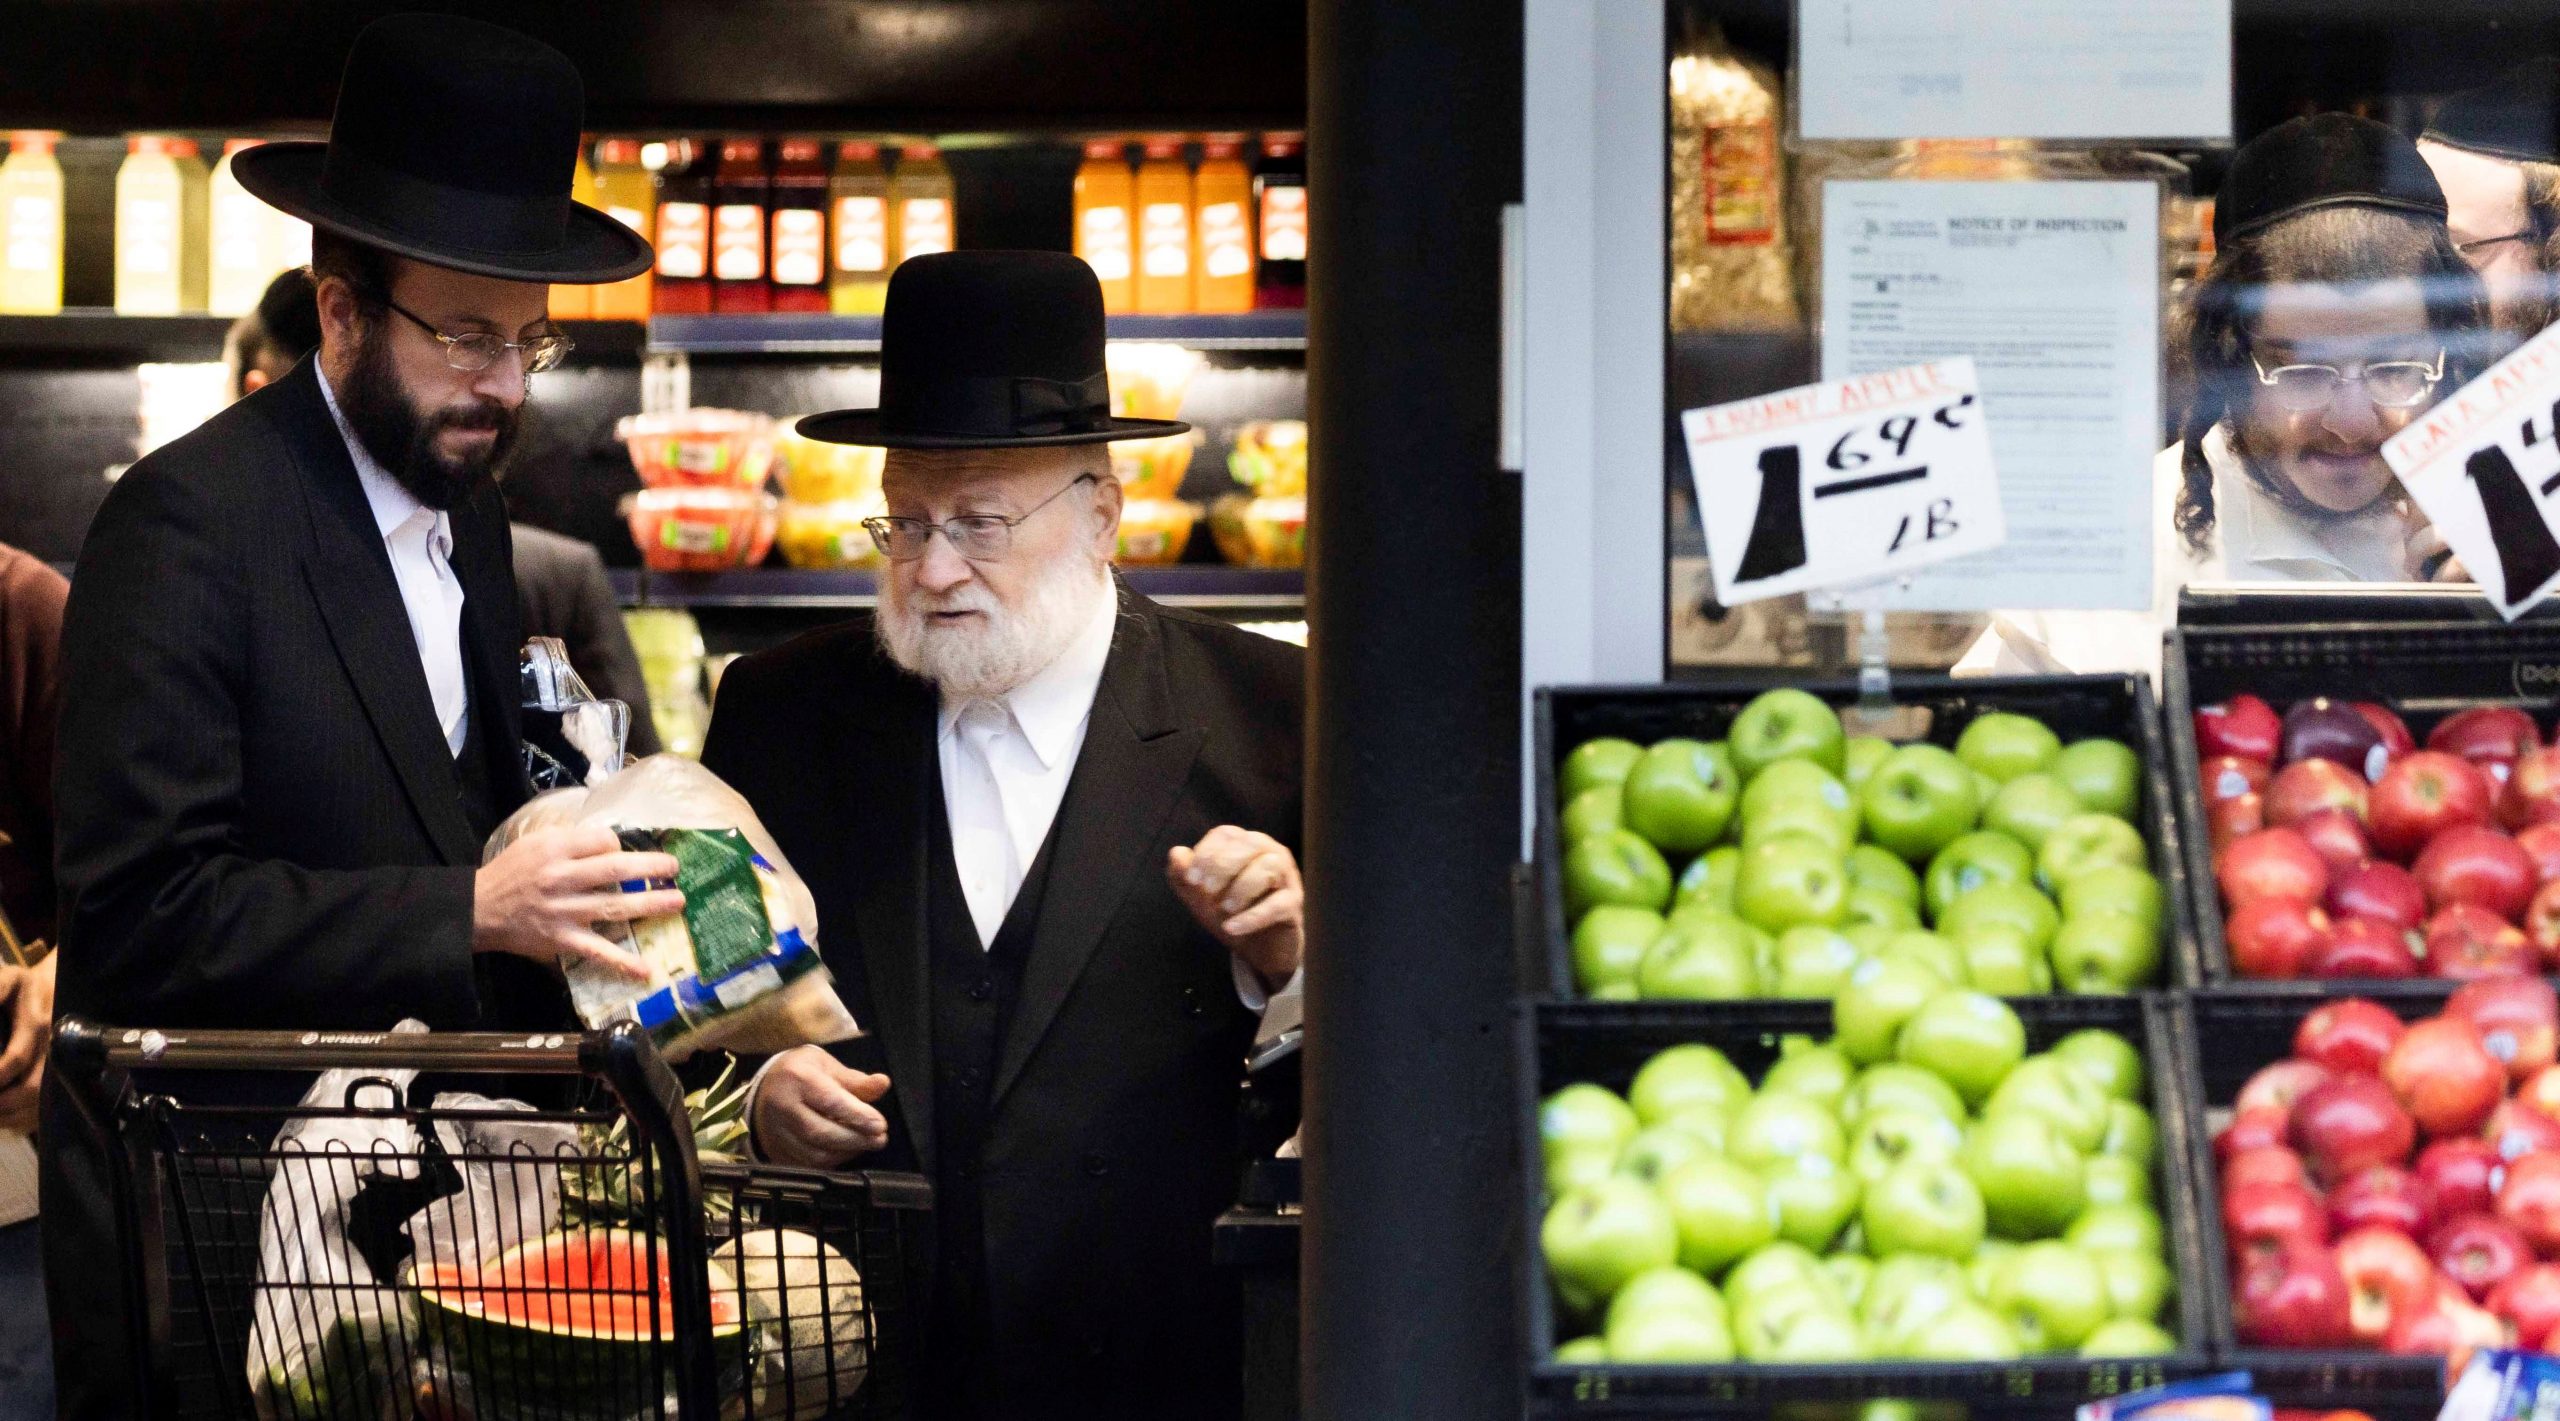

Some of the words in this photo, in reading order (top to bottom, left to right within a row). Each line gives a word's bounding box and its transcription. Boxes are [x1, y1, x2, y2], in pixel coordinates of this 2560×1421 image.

[1947, 217, 2002, 231] NOTICE
[2009, 217, 2027, 231] OF
[2034, 218, 2128, 232] INSPECTION
[1840, 362, 1947, 411] APPLE
